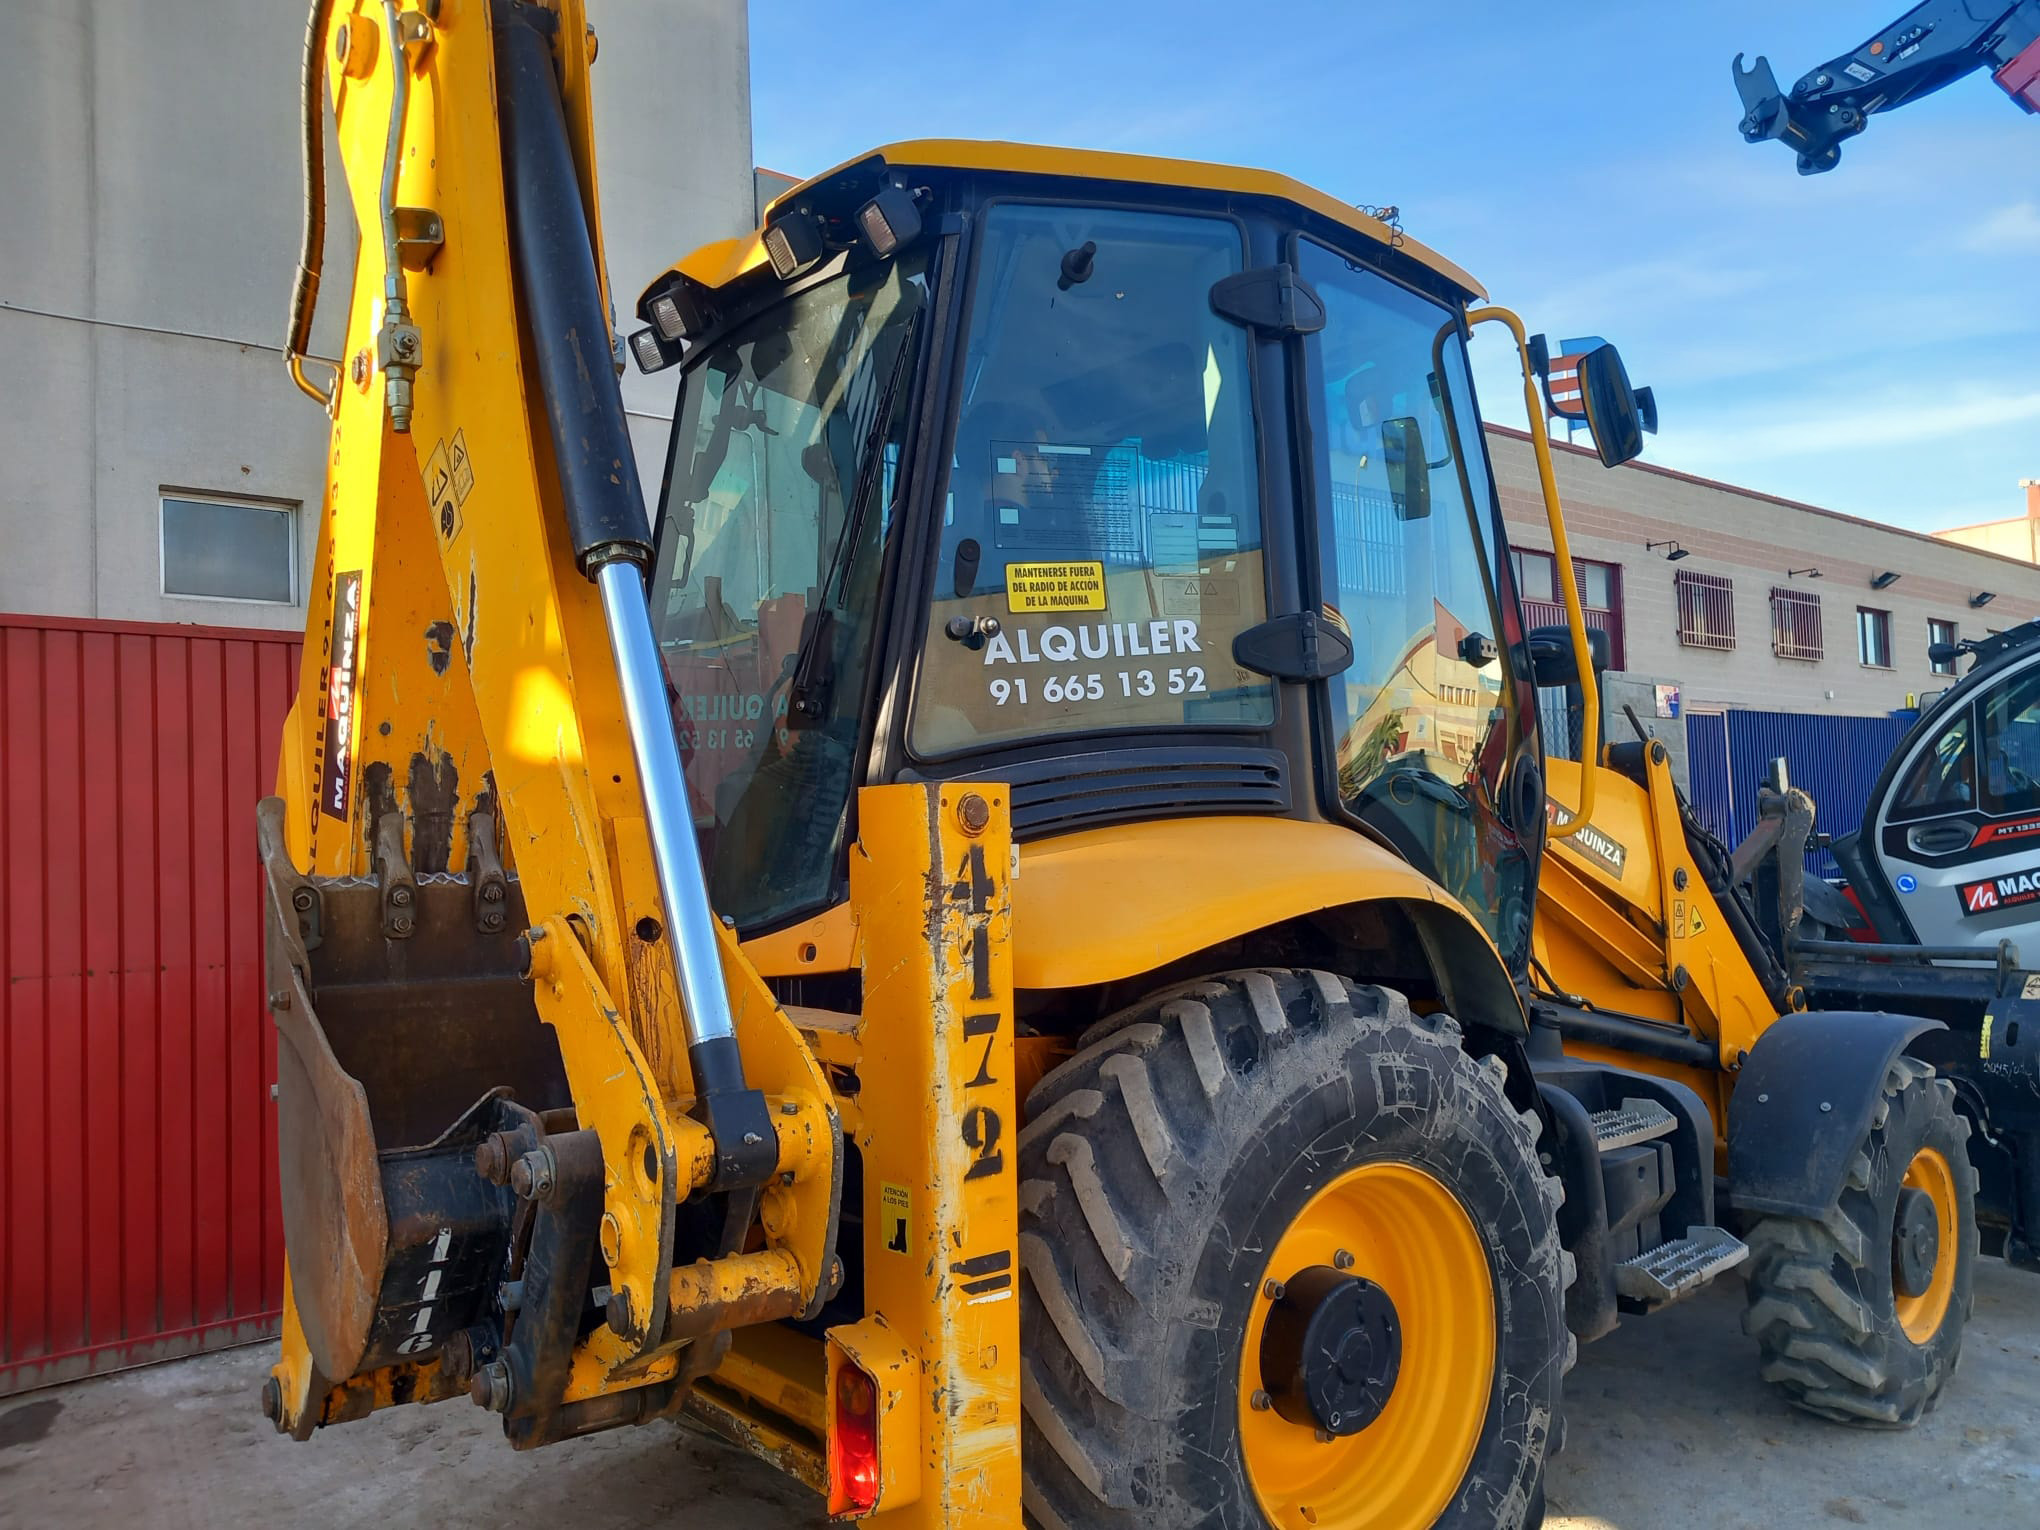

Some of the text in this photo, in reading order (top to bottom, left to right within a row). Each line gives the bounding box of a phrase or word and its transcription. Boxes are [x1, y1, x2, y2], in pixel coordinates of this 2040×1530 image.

[1012, 582, 1028, 593] DEL
[1029, 581, 1056, 592] RADIO
[1057, 581, 1068, 591] DE
[1014, 566, 1095, 578] MANTENERSE FUERA
[1025, 596, 1037, 607] DE
[1038, 596, 1049, 606] LA
[322, 618, 331, 656] 91
[983, 619, 1203, 665] ALQUILER
[334, 579, 357, 809] MAQUINZA
[988, 678, 1028, 706] 91
[1043, 673, 1105, 703] 665
[1118, 669, 1156, 697] 13
[1167, 666, 1207, 695] 52
[1556, 810, 1621, 867] MQUINZA
[887, 1196, 897, 1205] LOS
[898, 1198, 909, 1208] PIES
